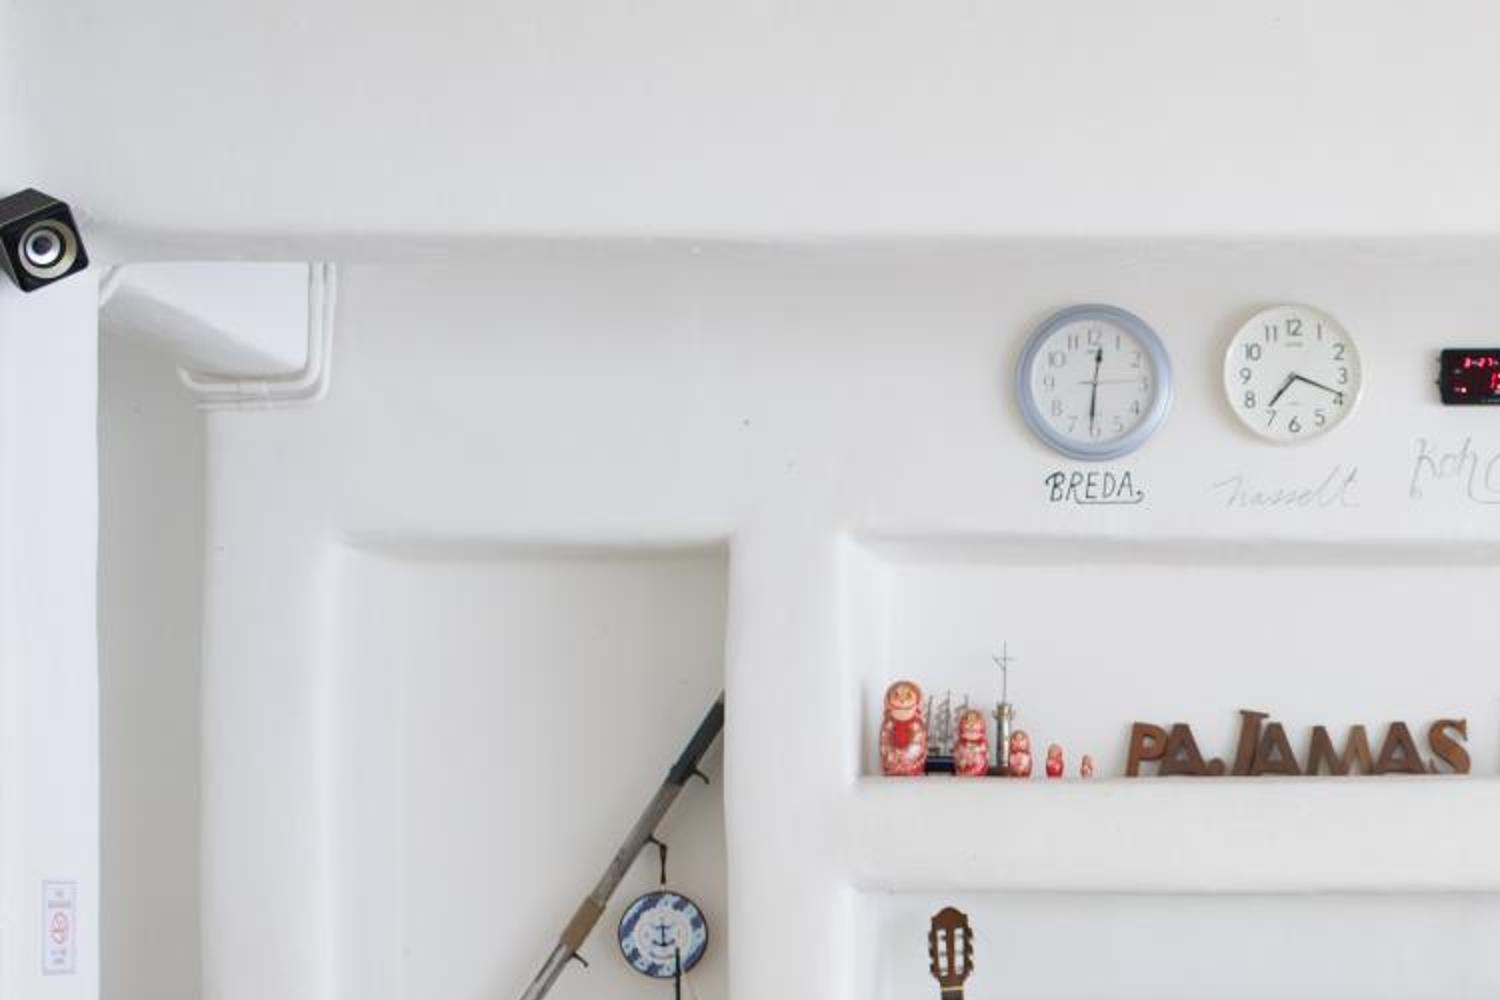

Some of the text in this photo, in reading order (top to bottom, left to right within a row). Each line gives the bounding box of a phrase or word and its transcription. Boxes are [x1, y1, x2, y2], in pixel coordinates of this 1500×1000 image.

[1264, 325, 1277, 342] 11
[1285, 319, 1302, 337] 12
[1244, 343, 1262, 361] 10
[1333, 343, 1345, 361] 2
[1240, 368, 1251, 385] 9
[1337, 368, 1348, 385] 3
[1244, 392, 1256, 409] 8
[1266, 409, 1277, 427] 7
[1288, 415, 1302, 433] 6
[1314, 408, 1326, 426] 5
